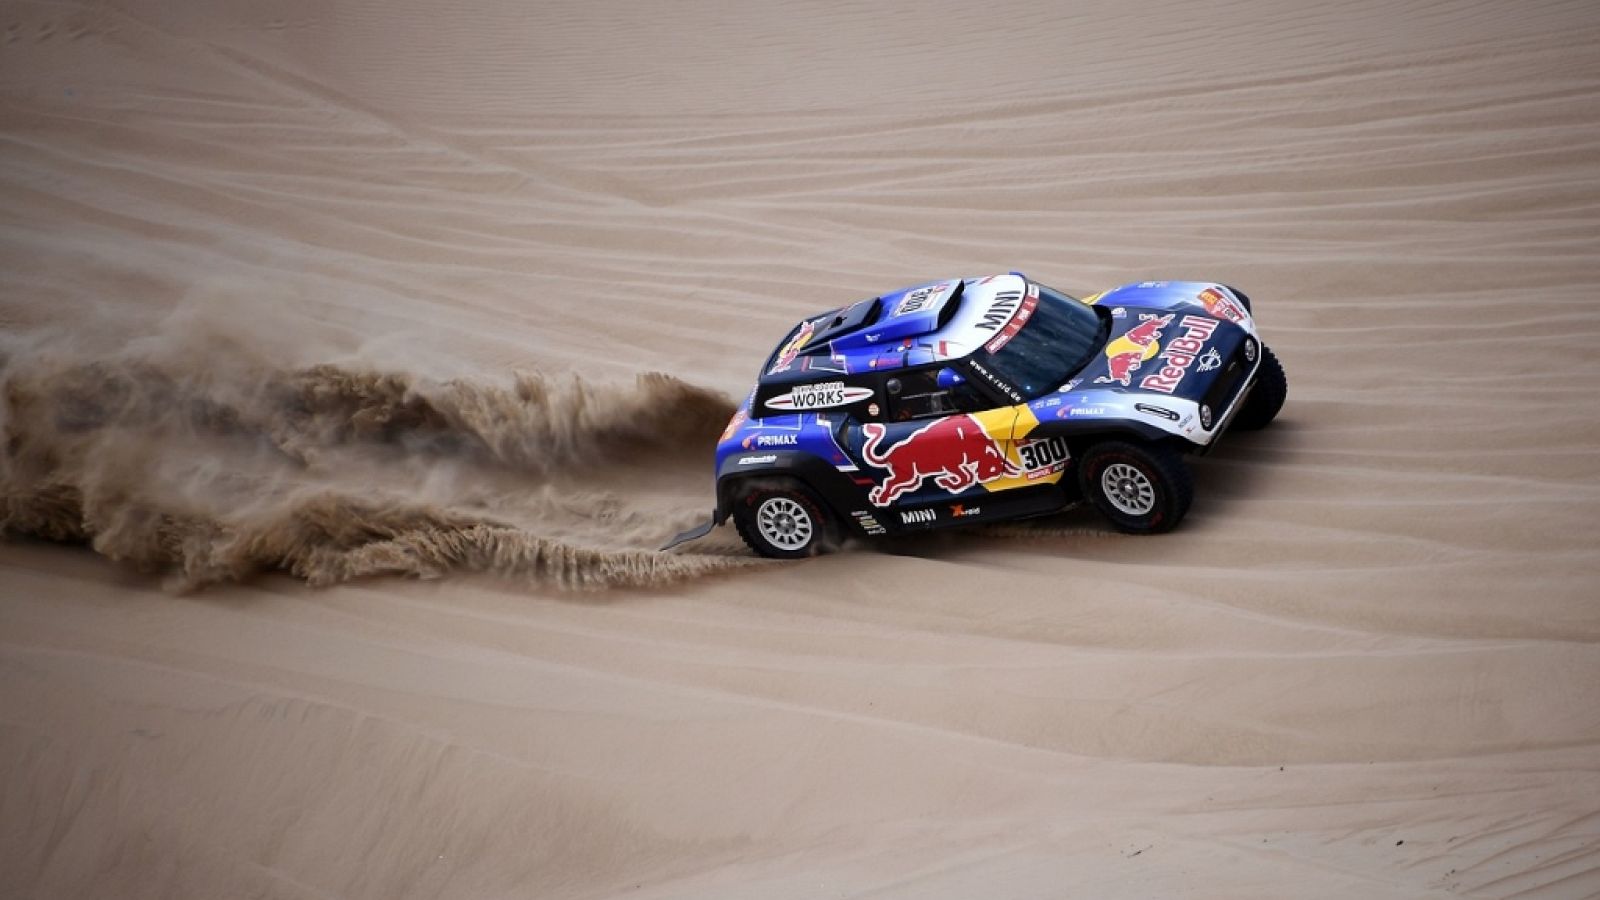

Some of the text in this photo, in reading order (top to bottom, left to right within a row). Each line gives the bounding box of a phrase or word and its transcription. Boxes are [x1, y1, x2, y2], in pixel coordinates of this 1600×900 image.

[974, 290, 1021, 331] MINI
[792, 390, 844, 408] WORKS
[1069, 407, 1105, 417] PRIMAX
[757, 434, 799, 447] PRIMAX
[1020, 438, 1067, 470] 300
[900, 508, 937, 524] MINI
